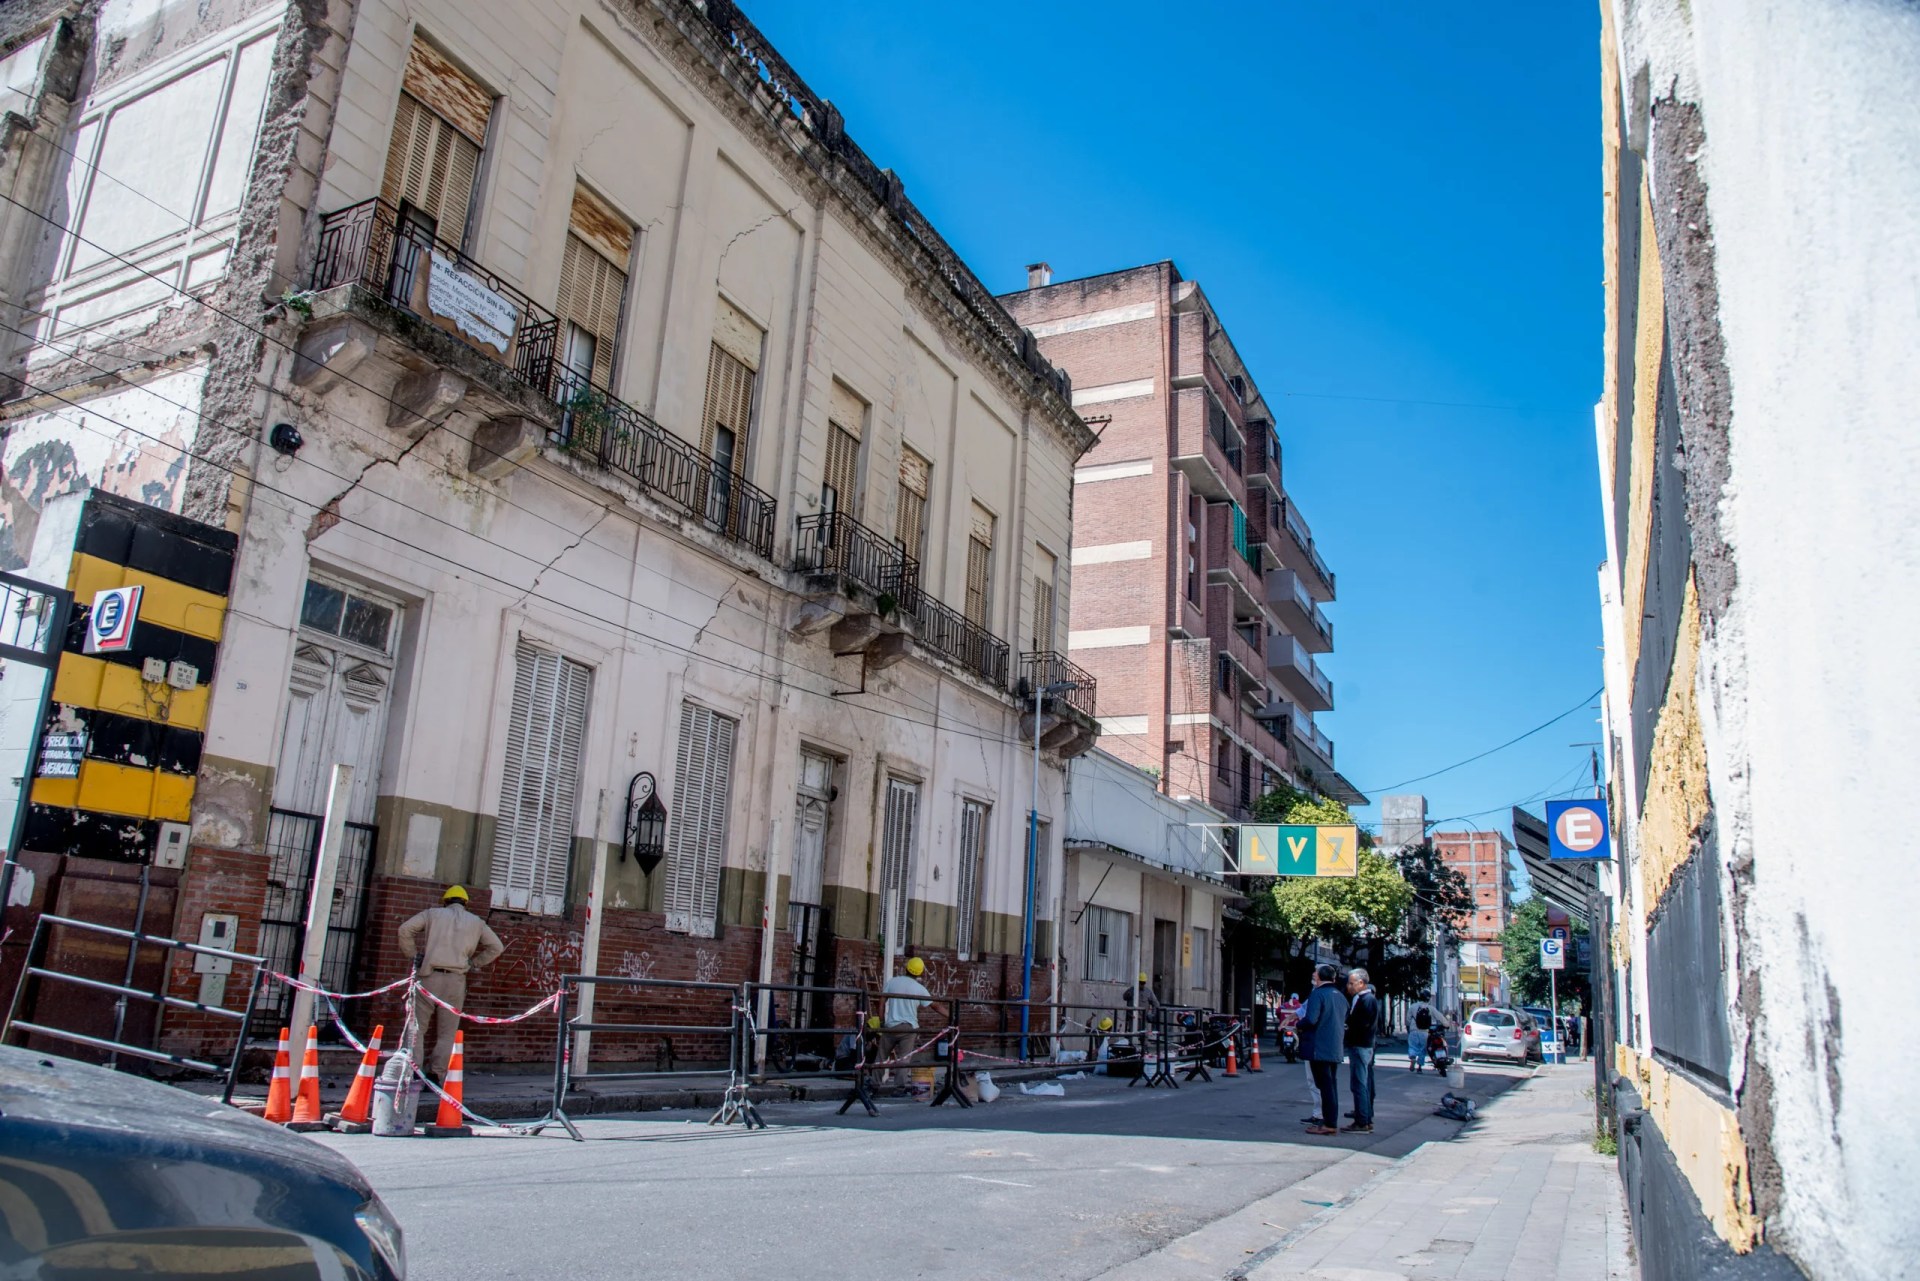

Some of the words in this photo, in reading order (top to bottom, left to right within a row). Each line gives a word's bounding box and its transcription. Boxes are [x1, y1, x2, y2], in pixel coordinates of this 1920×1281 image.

[487, 295, 498, 309] SIN
[498, 304, 517, 321] PLAN
[98, 599, 120, 629] E
[1565, 813, 1594, 846] E
[1546, 941, 1556, 953] E
[1555, 929, 1564, 939] E
